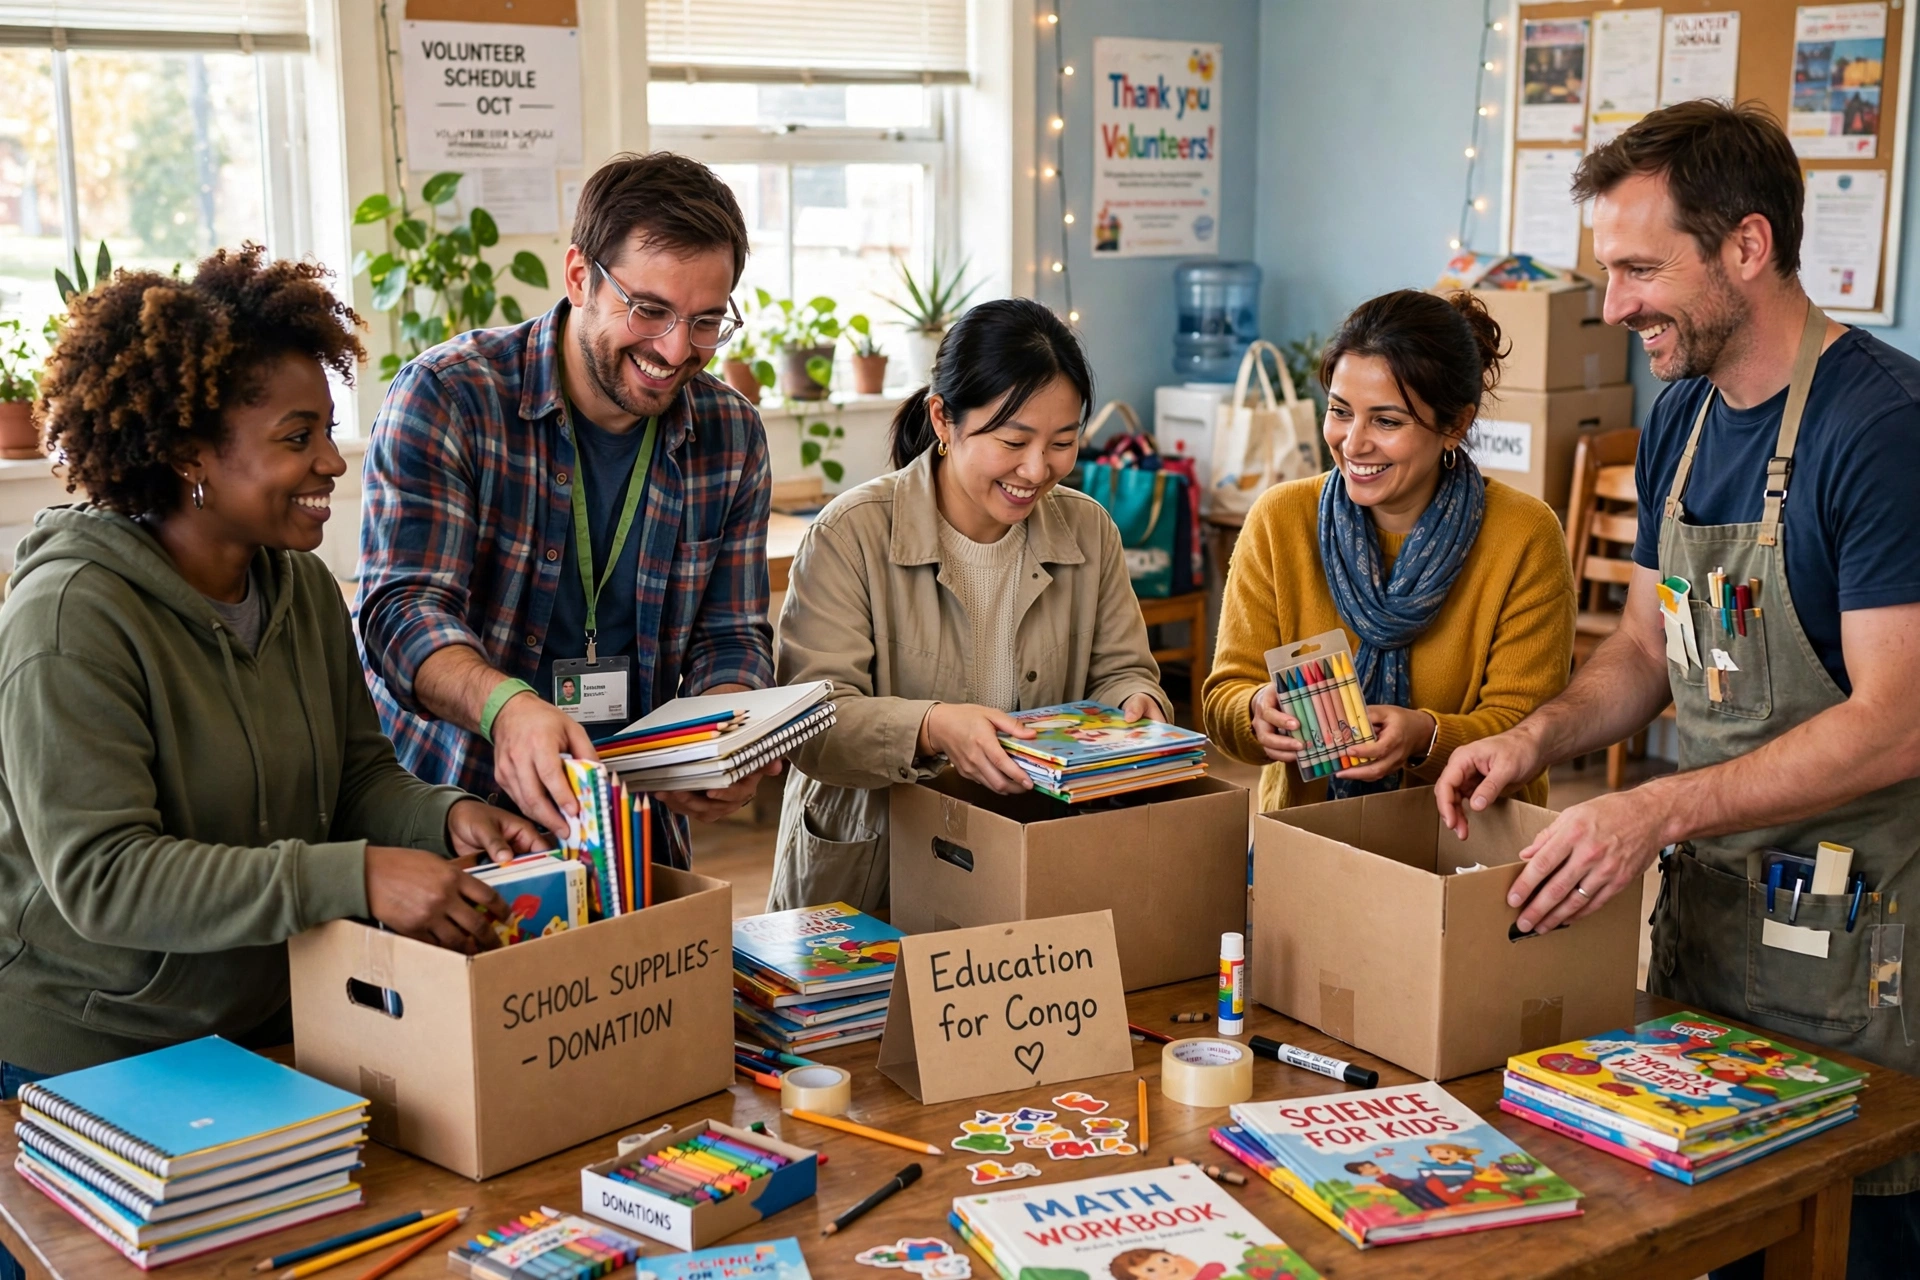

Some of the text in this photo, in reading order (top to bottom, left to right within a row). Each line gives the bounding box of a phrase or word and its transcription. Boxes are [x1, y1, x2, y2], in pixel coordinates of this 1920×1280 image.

[421, 40, 526, 63] VOLUNTEER
[444, 68, 536, 89] SCHEDULE
[1108, 73, 1210, 120] Thank you
[476, 96, 513, 115] OCT
[1102, 123, 1215, 160] Volunteers!
[930, 943, 1093, 993] Education
[503, 976, 598, 1030] SCHOOL
[939, 994, 1098, 1042] for Congo
[1279, 1093, 1440, 1128] SCIENCE
[1303, 1115, 1460, 1147] FOR KIDS
[602, 1191, 672, 1231] DONATIONS
[1023, 1183, 1175, 1223] MATH
[1024, 1203, 1226, 1248] WORKBOOK
